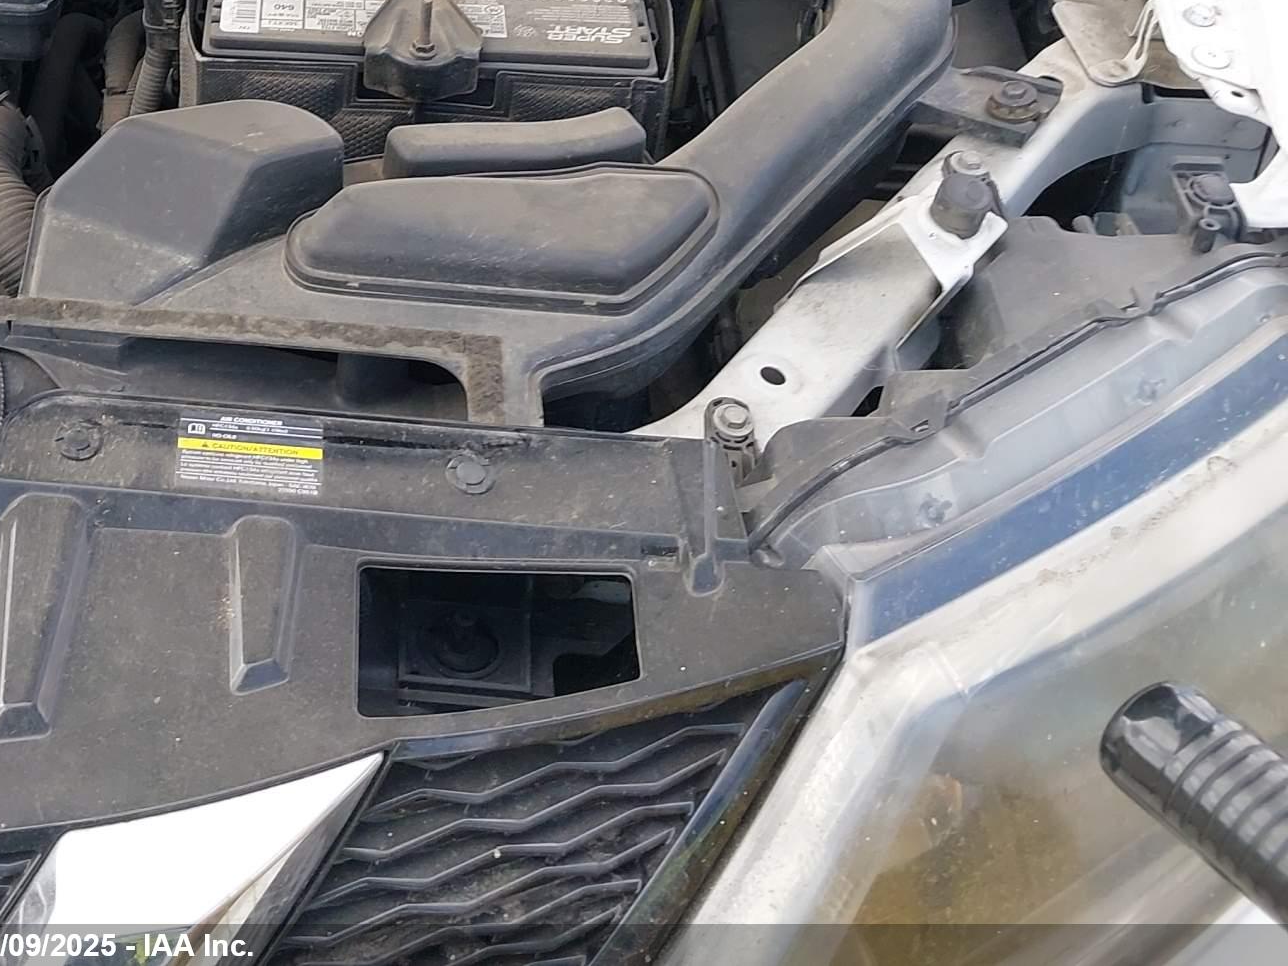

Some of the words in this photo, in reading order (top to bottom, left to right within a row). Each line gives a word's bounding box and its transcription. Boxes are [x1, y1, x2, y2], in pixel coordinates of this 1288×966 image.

[273, 3, 295, 11] 640
[545, 25, 633, 38] START
[547, 33, 624, 44] SUPER
[234, 416, 284, 426] CONDITIONER
